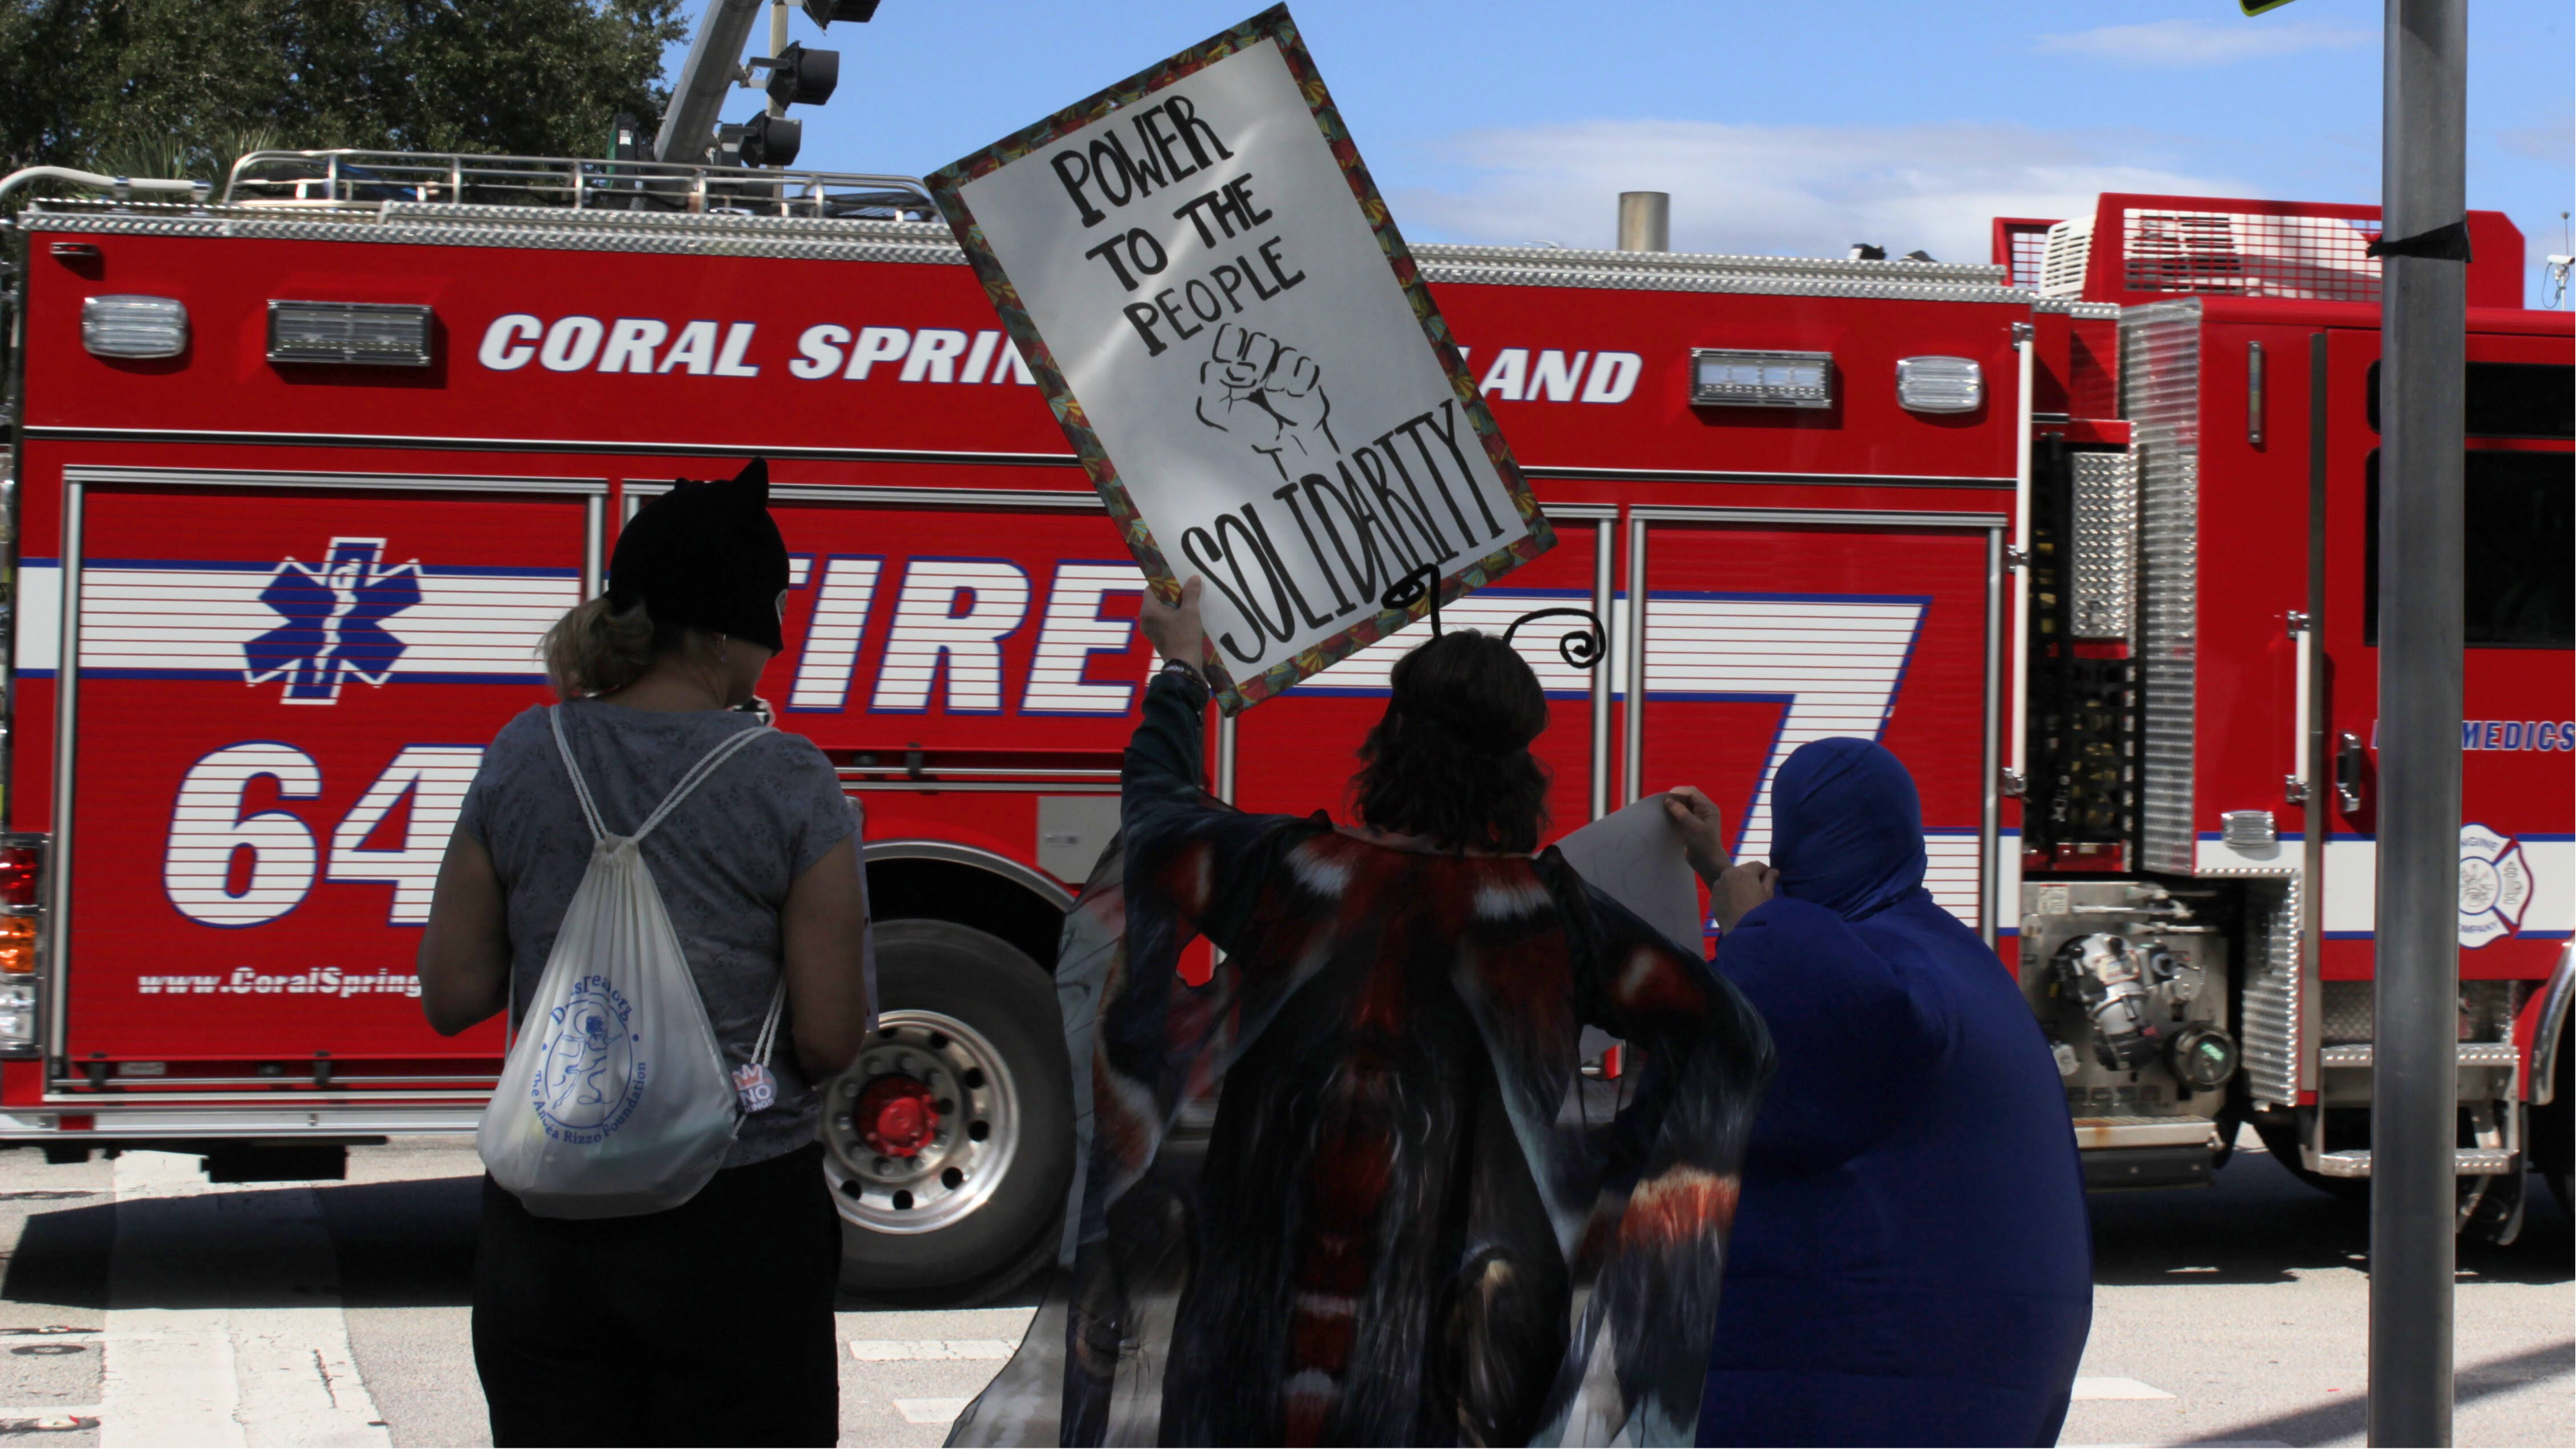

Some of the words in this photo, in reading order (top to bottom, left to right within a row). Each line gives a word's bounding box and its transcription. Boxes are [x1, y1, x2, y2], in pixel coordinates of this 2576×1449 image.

[1050, 95, 1234, 227] POWER
[1085, 227, 1169, 291] TO
[1173, 172, 1273, 248] THE
[1123, 235, 1306, 357] PEOPLE
[478, 313, 761, 378] CORAL
[788, 324, 1038, 385] SPRIN
[1458, 345, 1644, 404] AND
[1181, 398, 1505, 663] SOLIDARITY
[162, 739, 487, 929] 64
[138, 967, 421, 998] www.CoralSpring
[563, 1130, 602, 1144] Rizzo
[602, 1062, 645, 1137] Foundation
[740, 1084, 771, 1106] NO
